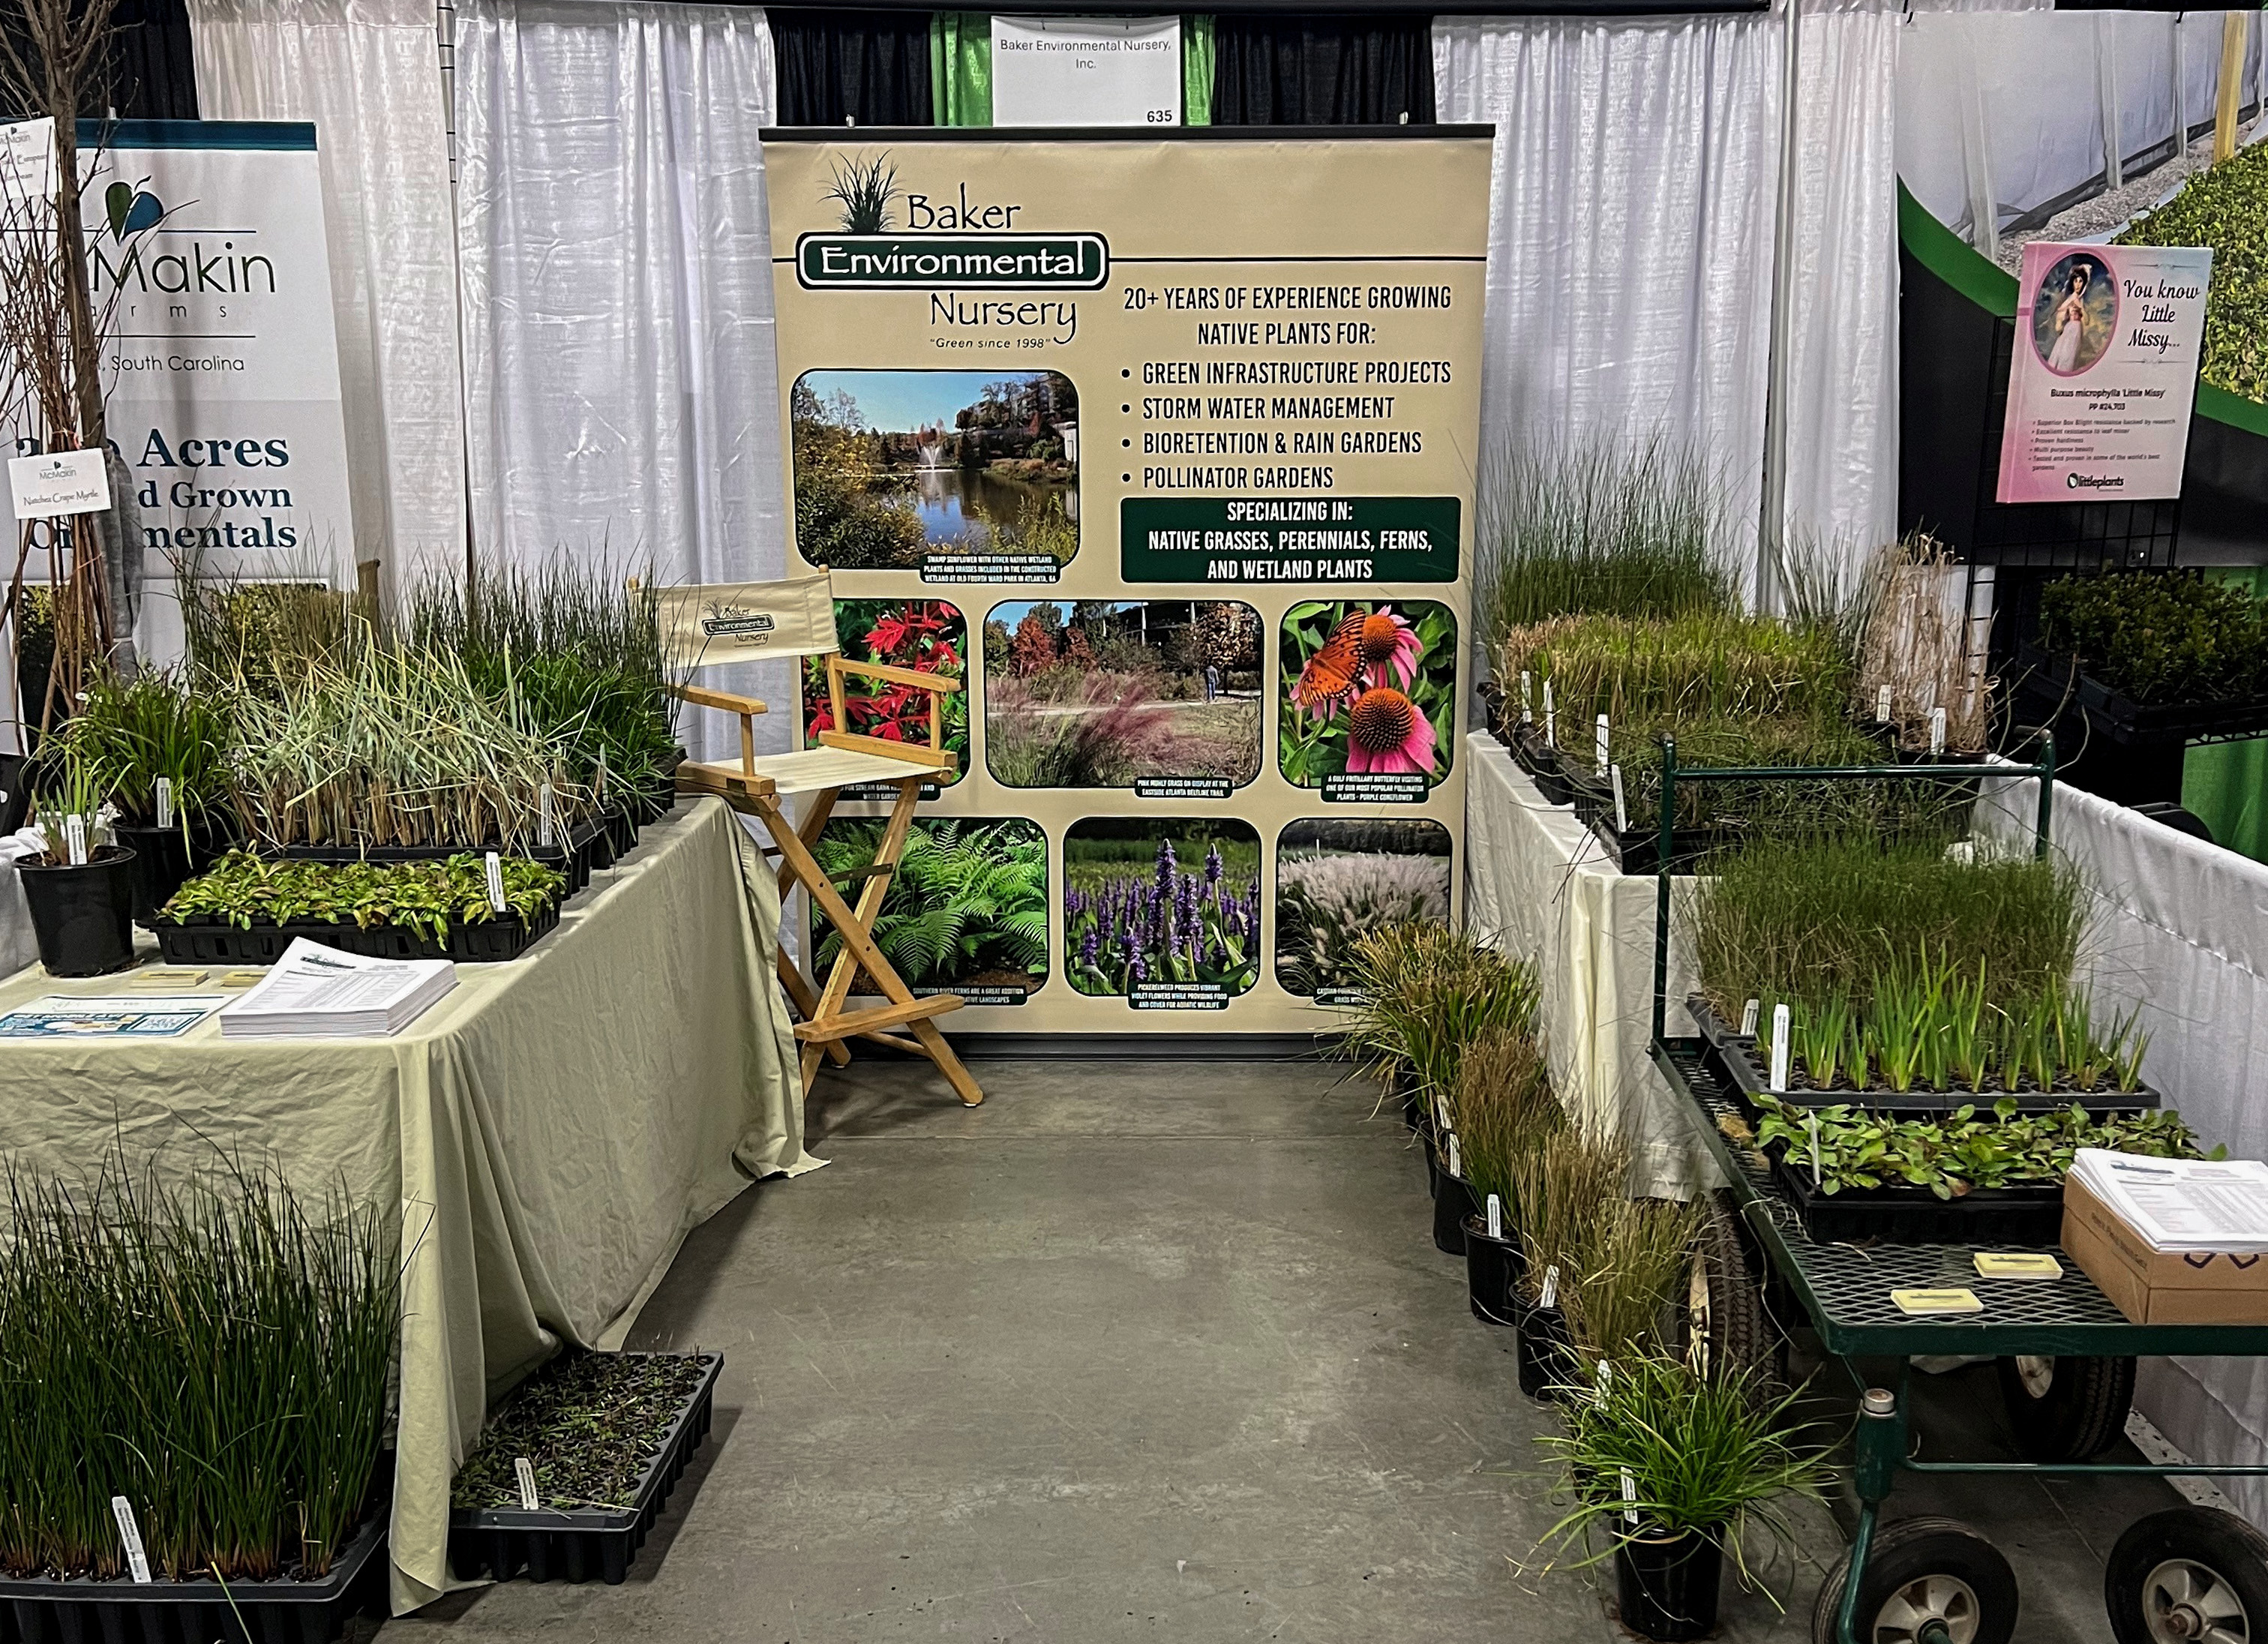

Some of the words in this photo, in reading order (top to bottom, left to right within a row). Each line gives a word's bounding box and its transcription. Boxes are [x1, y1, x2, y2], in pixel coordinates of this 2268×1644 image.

[1000, 39, 1034, 51] Baker
[1036, 39, 1120, 51] Environmental
[1124, 38, 1172, 53] Nursery,
[1076, 58, 1096, 69] Inc.
[1146, 110, 1172, 122] 635
[908, 183, 1022, 229] Baker
[820, 240, 1083, 275] Environmental
[1124, 287, 1159, 309] 20+
[1164, 287, 1220, 309] YEARS
[1225, 287, 1246, 309] OF
[1252, 287, 1362, 309] EXPERIENCE
[1367, 287, 1451, 309] GROWING
[2123, 279, 2153, 298] You
[2157, 279, 2200, 298] know
[930, 293, 1077, 344] Nursery
[2141, 304, 2176, 323] Little
[978, 338, 1012, 349] since
[1198, 322, 1259, 345] NATIVE
[1264, 322, 1330, 345] PLANTS
[1336, 322, 1376, 345] FOR:
[2128, 328, 2180, 355] Missy...
[111, 354, 163, 371] South
[168, 354, 245, 371] Carolina
[1143, 362, 1200, 384] GREEN
[1206, 362, 1359, 384] INFRASTRUCTURE
[1365, 362, 1451, 384] PROJECTS
[1143, 398, 1202, 419] STORM
[1208, 398, 1266, 419] WATER
[1271, 398, 1395, 419] MANAGEMENT
[136, 428, 290, 468] Acres
[1143, 432, 1268, 454] BIORETENTION
[1274, 432, 1286, 454] &
[1293, 432, 1335, 454] RAIN
[1340, 432, 1422, 454] GARDENS
[1143, 466, 1248, 488] POLLINATOR
[1253, 466, 1334, 488] GARDENS
[171, 481, 293, 508] Grown
[1227, 502, 1328, 520] SPECIALIZING
[1331, 502, 1353, 520] IN:
[1148, 531, 1201, 551] NATIVE
[1204, 531, 1274, 551] GRASSES,
[1278, 531, 1375, 551] PERENNIALS,
[1379, 531, 1432, 551] FERNS,
[1207, 560, 1238, 579] AND
[1242, 560, 1312, 579] WETLAND
[1317, 560, 1372, 579] PLANTS
[708, 616, 769, 631] Environmental
[735, 633, 769, 644] Nursery
